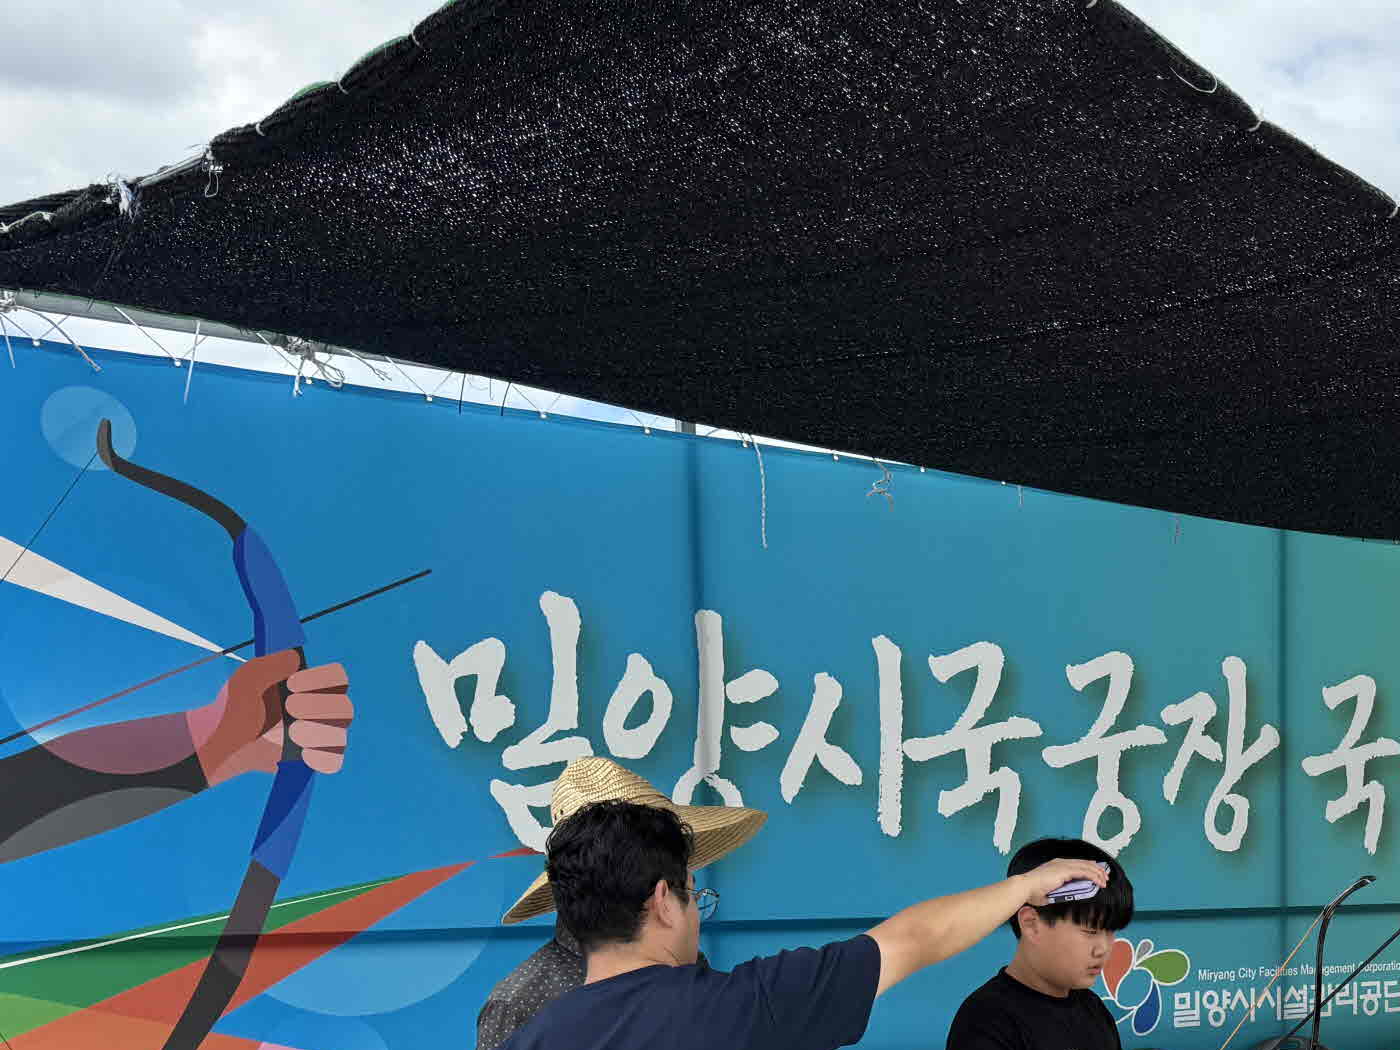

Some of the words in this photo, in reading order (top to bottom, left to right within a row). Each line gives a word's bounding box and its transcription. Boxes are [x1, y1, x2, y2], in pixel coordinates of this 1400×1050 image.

[1198, 968, 1236, 982] Miryang
[1238, 966, 1257, 980] City
[1300, 961, 1355, 976] Magement
